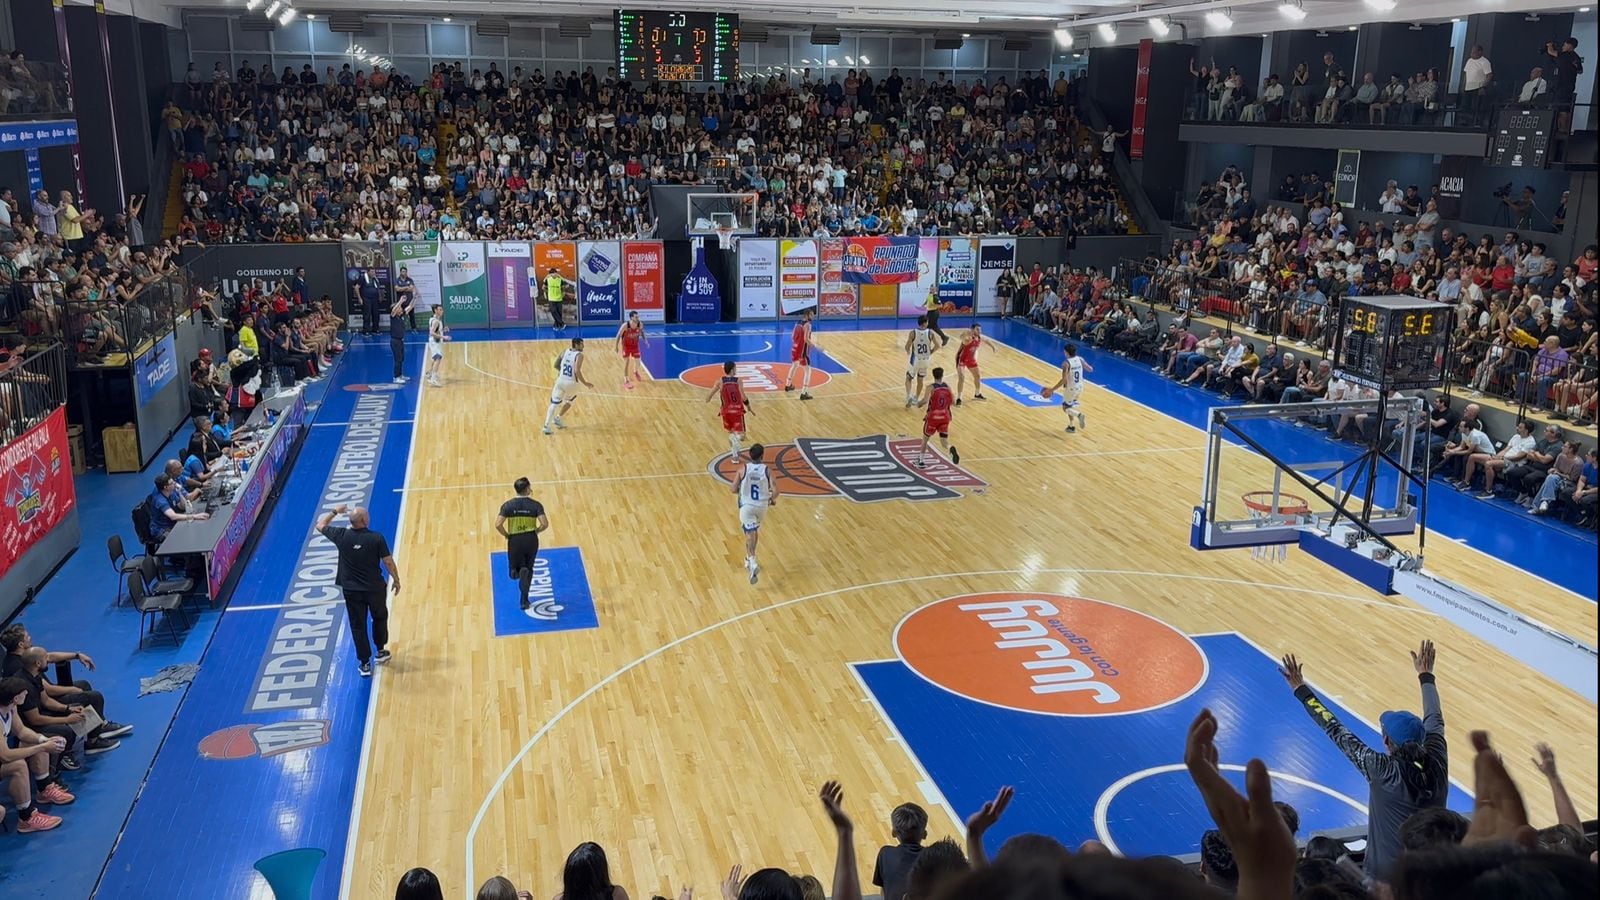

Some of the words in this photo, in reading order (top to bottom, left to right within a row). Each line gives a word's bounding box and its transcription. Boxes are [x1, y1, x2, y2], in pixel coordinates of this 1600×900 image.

[1440, 176, 1464, 193] ACACIA
[236, 268, 282, 276] GOBIERNO
[284, 268, 294, 276] DE
[982, 260, 1012, 268] JEMSE
[450, 296, 472, 304] SALUD
[917, 344, 928, 354] 20
[148, 359, 170, 388] TADE
[562, 364, 572, 377] 29
[1074, 370, 1080, 383] 9
[352, 394, 390, 422] JUJUY
[810, 441, 938, 497] JUJUY
[750, 484, 759, 500] 6
[1416, 584, 1518, 636] www.fmequipamientos.com.ar
[1047, 618, 1080, 647] gente
[958, 600, 1121, 704] Jujuy
